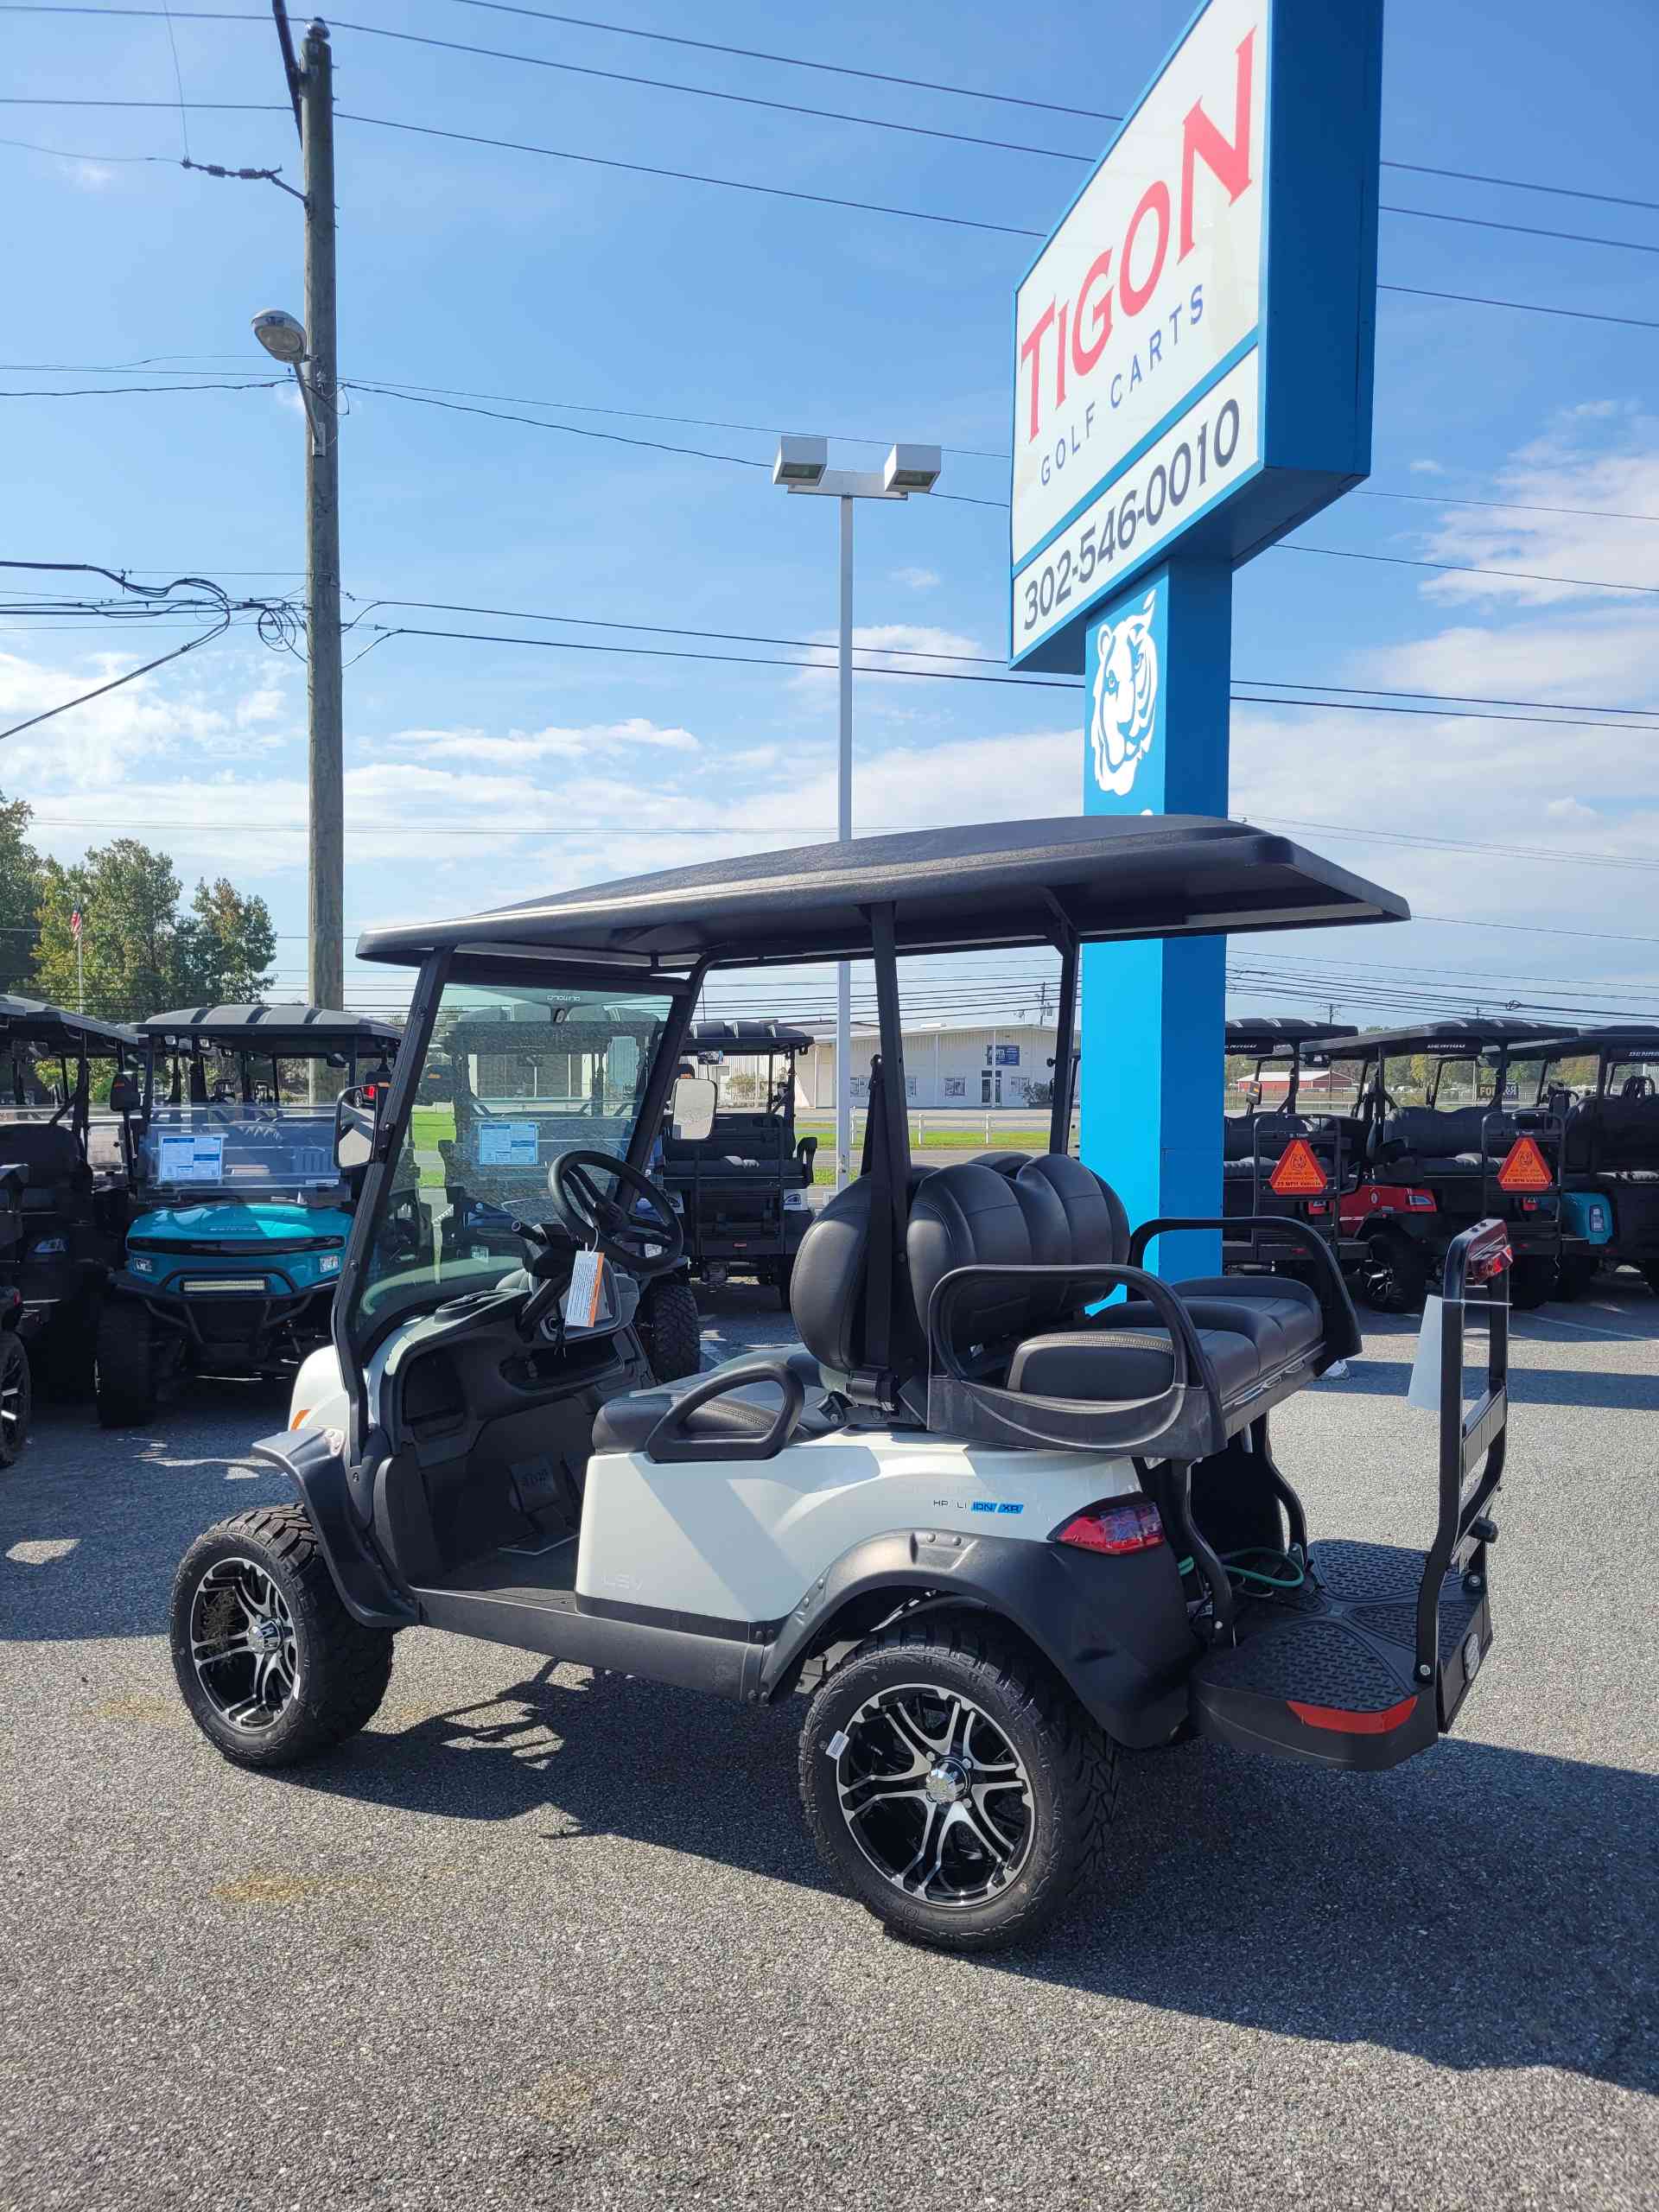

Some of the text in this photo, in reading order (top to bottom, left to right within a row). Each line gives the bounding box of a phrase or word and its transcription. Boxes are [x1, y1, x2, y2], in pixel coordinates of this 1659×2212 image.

[1020, 24, 1257, 444] TIGON
[1040, 284, 1204, 486] GOLF CARTS
[1023, 398, 1241, 631] 302-546-0010
[1001, 1503, 1020, 1514] XR
